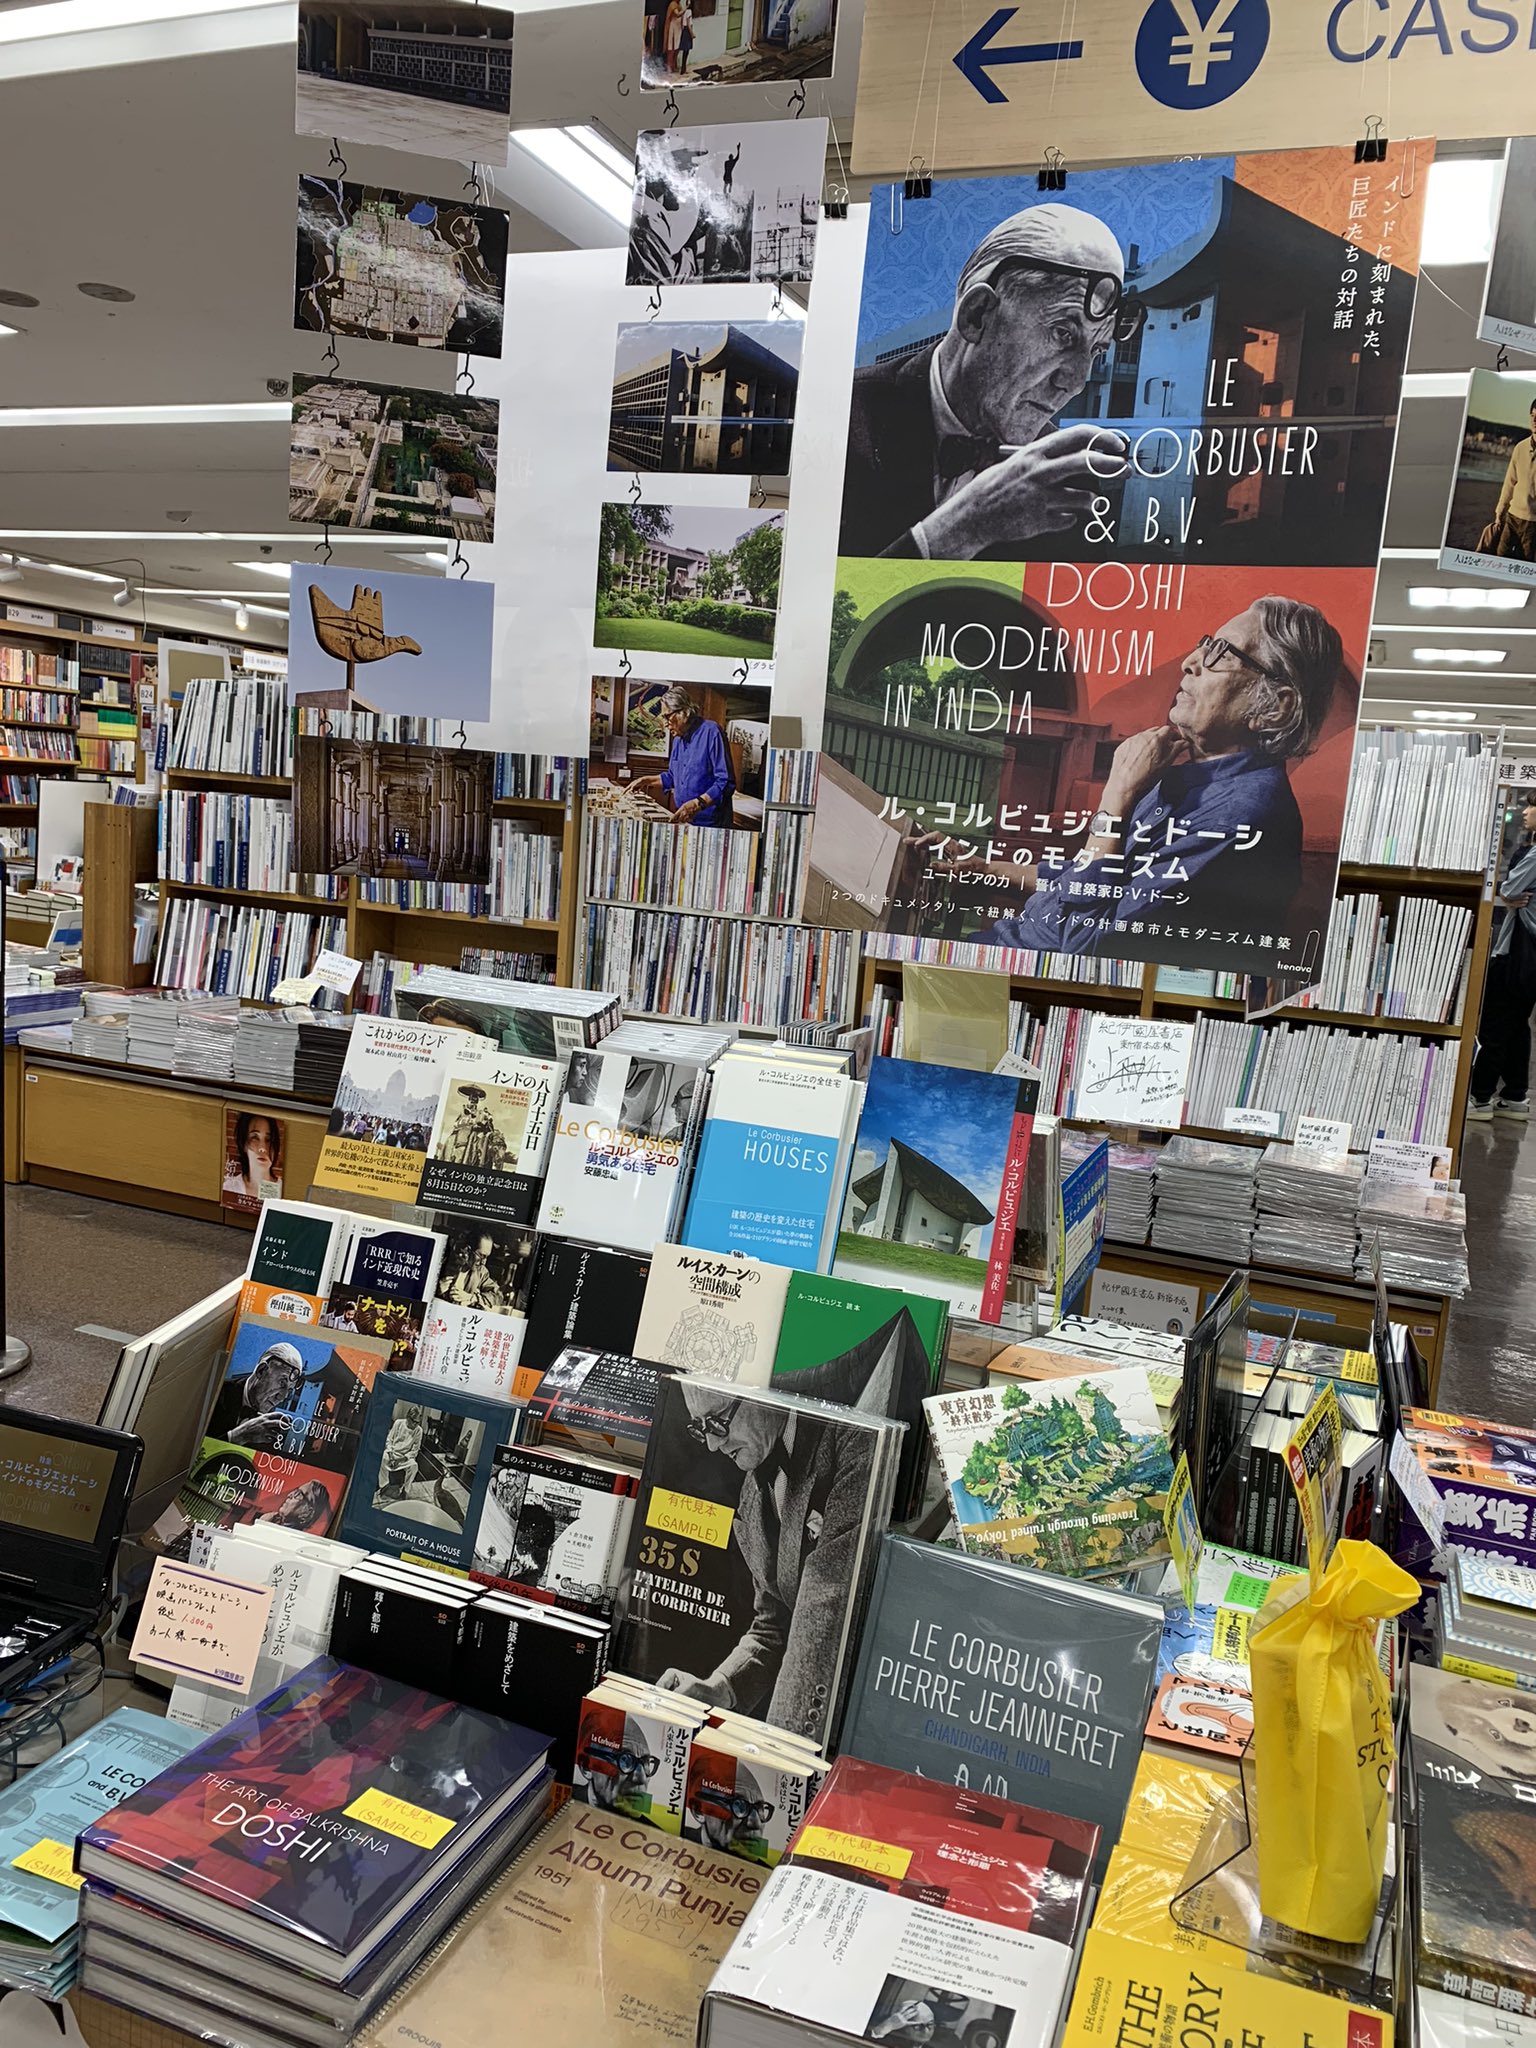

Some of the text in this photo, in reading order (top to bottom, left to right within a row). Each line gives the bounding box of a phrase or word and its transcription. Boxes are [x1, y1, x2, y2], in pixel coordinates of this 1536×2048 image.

[1326, 0, 1536, 63] CAS
[1332, 175, 1372, 330] 巨匠たちの対話
[1362, 174, 1401, 358] インドに刻まれた、
[1206, 357, 1239, 408] LE
[1084, 425, 1319, 479] CORBUSIER
[1083, 496, 1205, 546] & B.V.
[1046, 561, 1187, 612] DOSHI
[920, 622, 1156, 677] MODERNISM
[882, 683, 1034, 736] IN INDIA
[1499, 763, 1536, 782] 建築
[876, 795, 1264, 851] ル・コルビュジエとドーシ
[928, 833, 1191, 883] インドのモダニズム
[922, 867, 1010, 889] ユートピアの力
[364, 1024, 448, 1048] これからのインド
[758, 1068, 842, 1089] ル・コルビュジエの全住宅
[556, 1114, 683, 1155] Le Corbusier
[748, 1127, 803, 1145] Le Corbusier
[743, 1140, 829, 1174] HOUSES
[429, 1166, 529, 1192] なぜ、インドの独立記念日は
[998, 1157, 1025, 1232] ル・コルビュジエ
[731, 1208, 816, 1230] 建築の歴史を変えた住宅
[262, 1246, 290, 1261] インド
[362, 1257, 421, 1281] インド近現代史
[676, 1256, 761, 1285] ルイス・カーンの
[688, 1274, 742, 1299] 空間構成
[797, 1293, 843, 1308] ル・コルビュジエ
[374, 1317, 386, 1335] を
[314, 1400, 325, 1417] LE
[938, 1393, 997, 1417] 東京幻想
[273, 1434, 284, 1451] &
[278, 1414, 340, 1444] CORBUSIER
[257, 1451, 299, 1476] DOSHI
[1, 1470, 76, 1497] インドのモダニズム
[198, 1480, 246, 1507] IN INDIA
[217, 1463, 285, 1495] MODERNISM
[656, 1513, 719, 1543] (SAMPLE)
[1009, 1525, 1046, 1542] ruined
[1048, 1517, 1090, 1538] through
[1091, 1508, 1140, 1529] Traveling
[384, 1526, 418, 1545] PORTRAIT
[418, 1537, 429, 1549] OF
[436, 1543, 462, 1557] HOUSE
[634, 1568, 726, 1608] L'ATELIER DE
[271, 1568, 303, 1656] ル・コルビュジエが
[369, 1590, 385, 1635] 輝く都市
[631, 1584, 732, 1627] LE CORBUSIER
[500, 1619, 520, 1695] 建築をめざして
[909, 1618, 1104, 1715] LE CORBUSIER
[874, 1655, 1125, 1770] PIERRE JEANNERET
[599, 1735, 622, 1750] Corbusier
[923, 1718, 1051, 1778] CHANDIGARH, INDIA
[87, 1779, 108, 1793] and
[100, 1764, 147, 1789] LE CO
[666, 1727, 690, 1816] ル・コルビュジエ
[710, 1781, 735, 1796] Corbusier
[201, 1772, 390, 1857] THE ART OF BALKRISHNA
[357, 1808, 429, 1845] (SAMPLE)
[211, 1802, 333, 1864] DOSHI
[574, 1811, 761, 1895] Le Corbusie
[808, 1843, 893, 1876] (SAMPLE)
[939, 1842, 1009, 1867] ル・コルビュジエ
[25, 1860, 83, 1887] (SAMPLE
[534, 1864, 572, 1888] 1951
[548, 1839, 747, 1929] Album Punja
[906, 1920, 982, 1948] 20世紀最大の建築家の
